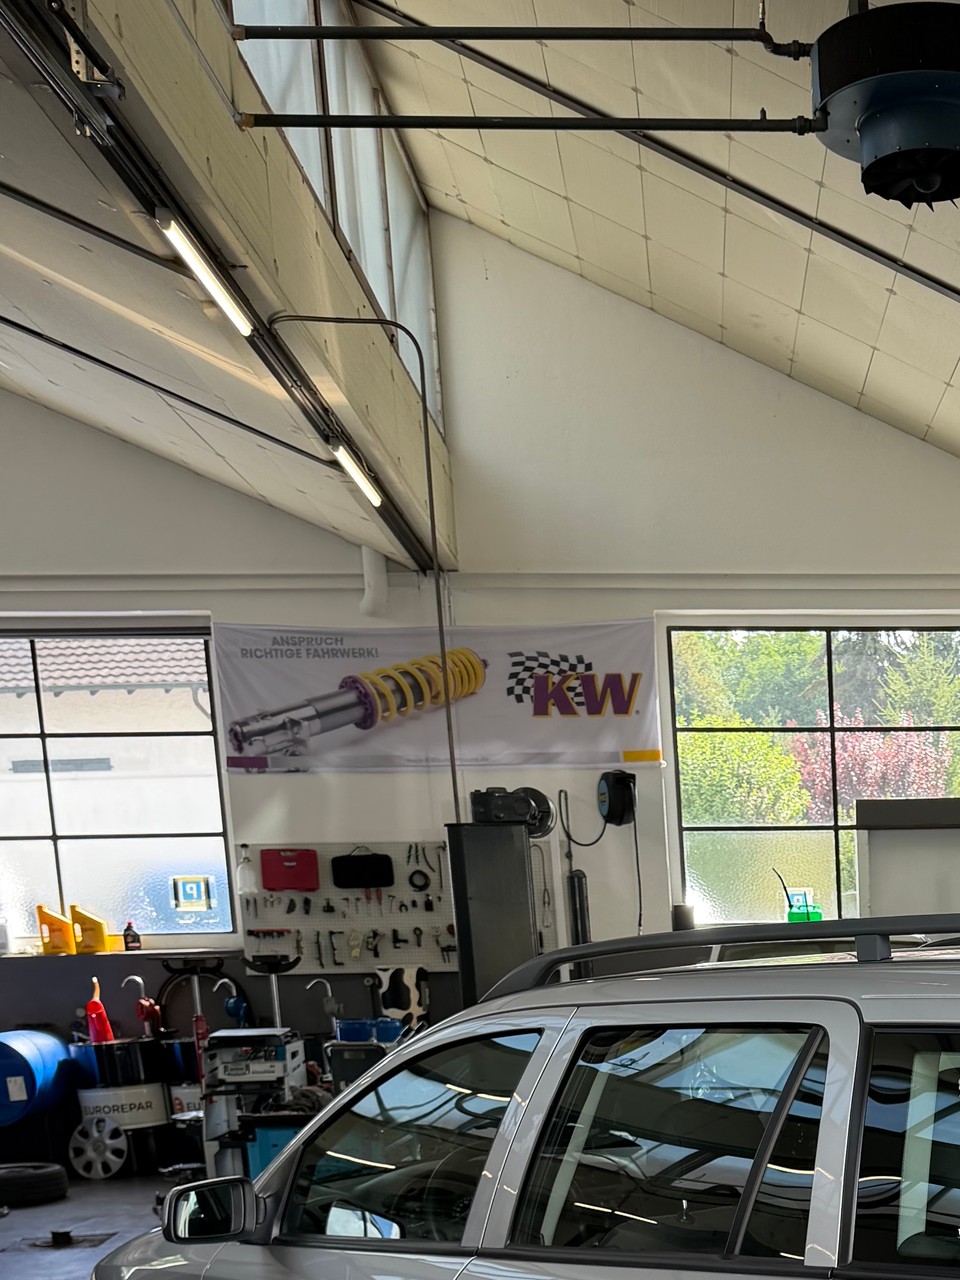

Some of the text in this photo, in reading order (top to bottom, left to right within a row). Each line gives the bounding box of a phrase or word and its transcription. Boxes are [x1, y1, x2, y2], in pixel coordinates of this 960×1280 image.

[271, 636, 344, 647] ANSPRUCH
[240, 648, 303, 660] RICHTIGE
[306, 647, 379, 660] FAHRWERK!
[532, 672, 643, 718] KW
[83, 1100, 154, 1116] EUROREPAR
